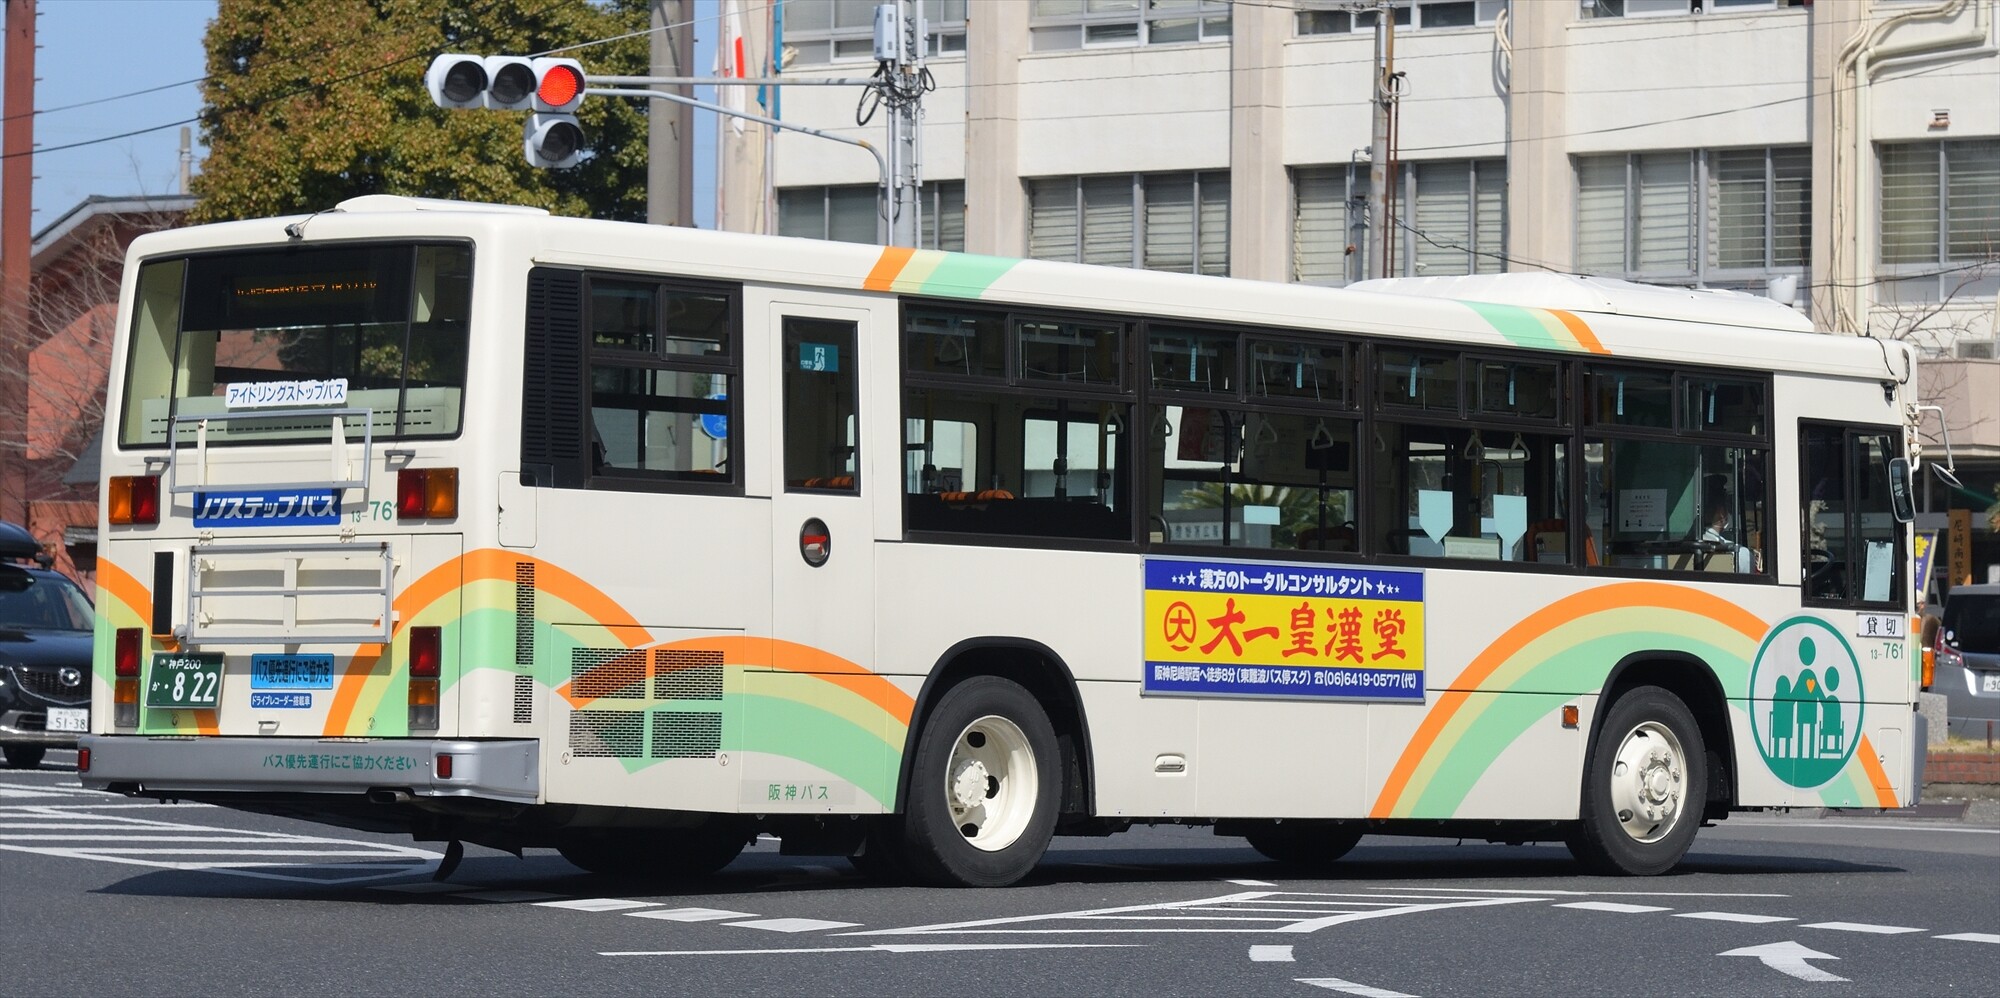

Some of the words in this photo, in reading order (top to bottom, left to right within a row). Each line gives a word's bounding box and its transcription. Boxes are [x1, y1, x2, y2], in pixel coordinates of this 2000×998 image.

[197, 495, 337, 519] ノンステップバス
[351, 501, 397, 523] 13-76
[1200, 569, 1372, 596] 漢方のトータルコンサルタント
[1200, 597, 1406, 664] 大一皇漢堂
[1867, 616, 1896, 635] 貸切
[1871, 642, 1904, 660] 13-761
[255, 659, 330, 684] バス優先運行にご協力を
[251, 695, 311, 707] ドライブレコーダー搭載車
[55, 717, 86, 729] 51-38
[263, 754, 417, 770] バス優先運行にご協力ください
[768, 784, 828, 801] 阪神バス
